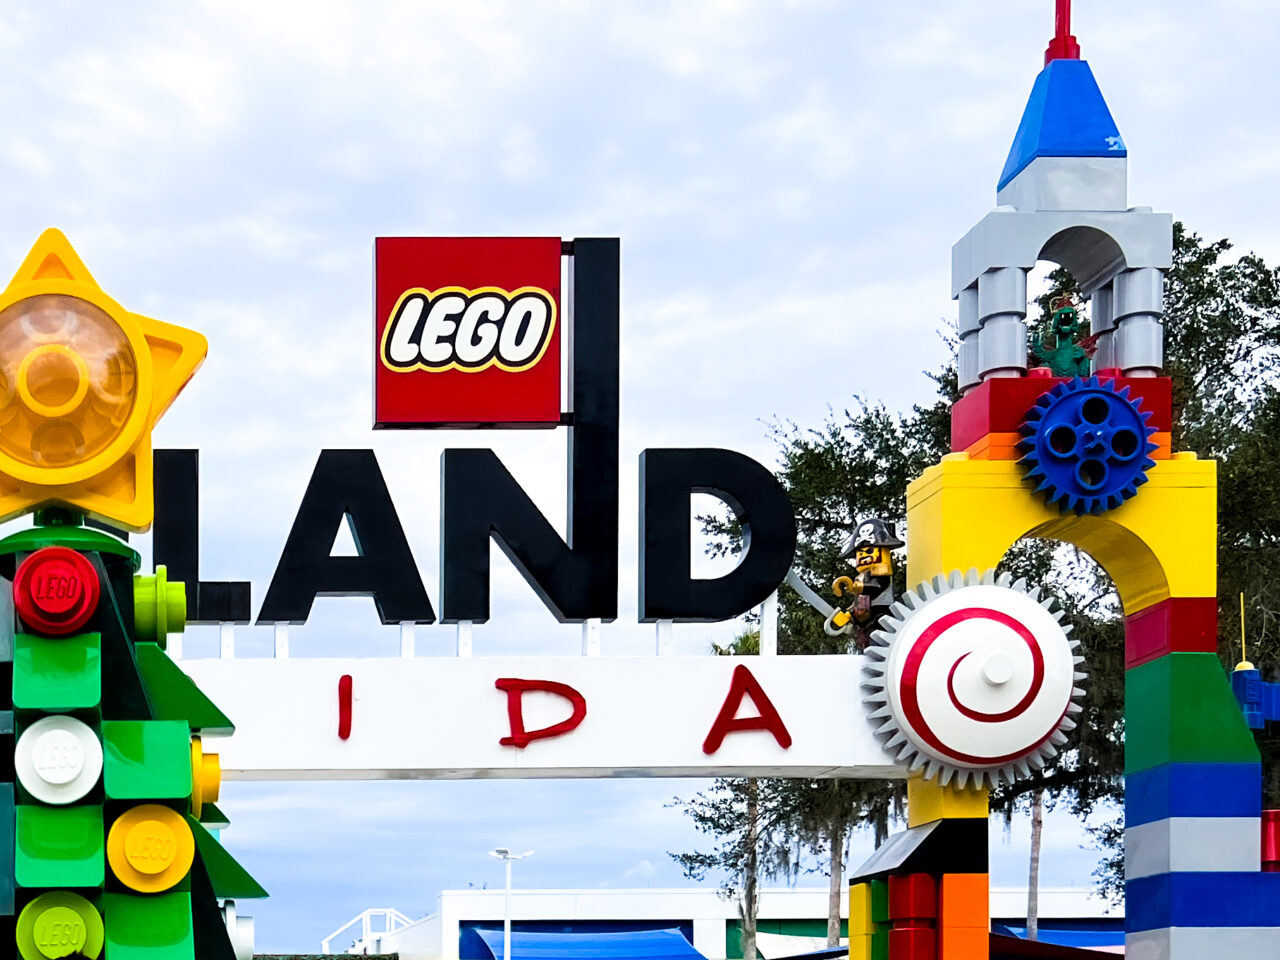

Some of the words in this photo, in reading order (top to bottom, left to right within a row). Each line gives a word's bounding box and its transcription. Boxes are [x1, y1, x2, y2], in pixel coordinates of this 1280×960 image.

[389, 296, 548, 363] LEGO
[36, 576, 78, 600] LEGO
[37, 746, 79, 770] LEGO
[130, 836, 173, 861] LEGO
[39, 921, 81, 947] LEGO
